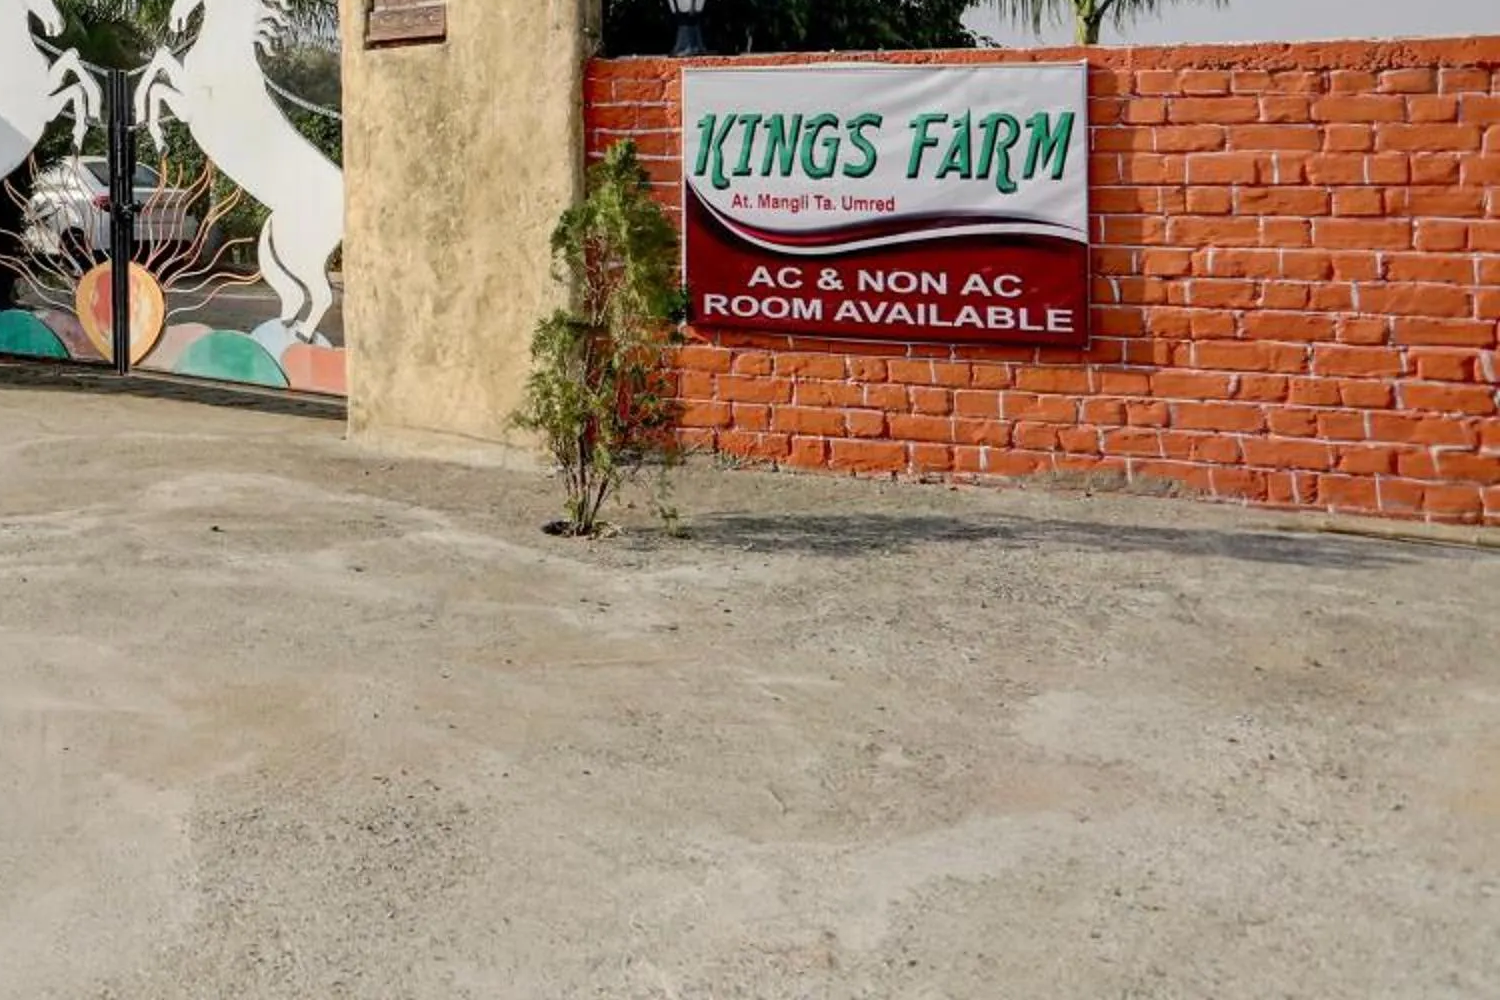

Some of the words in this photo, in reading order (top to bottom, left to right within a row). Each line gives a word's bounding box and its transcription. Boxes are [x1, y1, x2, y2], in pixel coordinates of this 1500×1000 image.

[694, 112, 882, 190] KINGS
[906, 108, 1075, 194] FARM
[731, 193, 753, 209] At.
[814, 195, 836, 211] Ta.
[841, 195, 896, 212] Umred
[748, 265, 803, 289] AC
[817, 267, 844, 291] &
[857, 270, 947, 295] NON
[960, 273, 1023, 298] AC
[703, 293, 823, 321] ROOM
[834, 299, 1075, 333] AVAILABLE
